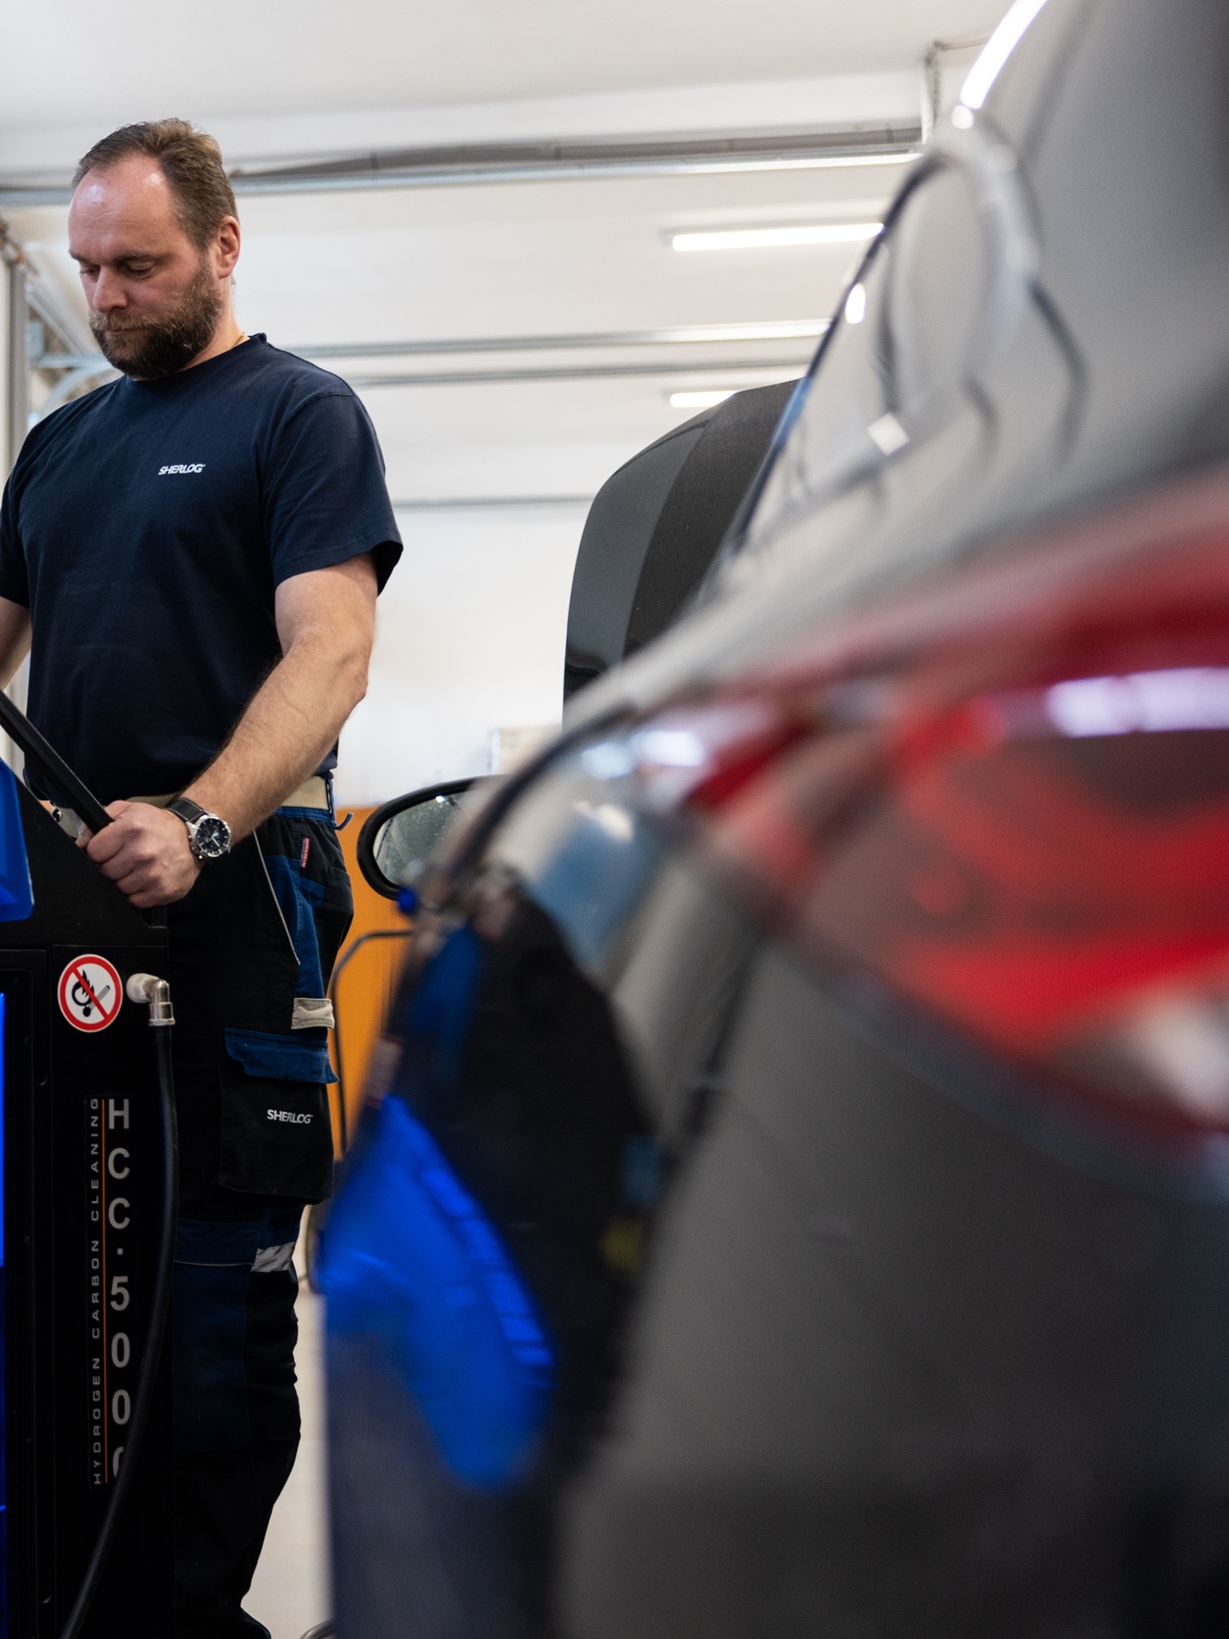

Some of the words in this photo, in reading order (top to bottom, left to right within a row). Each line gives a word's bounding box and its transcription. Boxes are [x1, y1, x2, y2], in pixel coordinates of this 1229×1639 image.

[157, 463, 205, 475] SHERLOG
[90, 1098, 100, 1222] CLEANING
[266, 1109, 313, 1124] SHERLOG
[91, 1240, 100, 1339] CARBON
[92, 1357, 102, 1485] HYDROGEN
